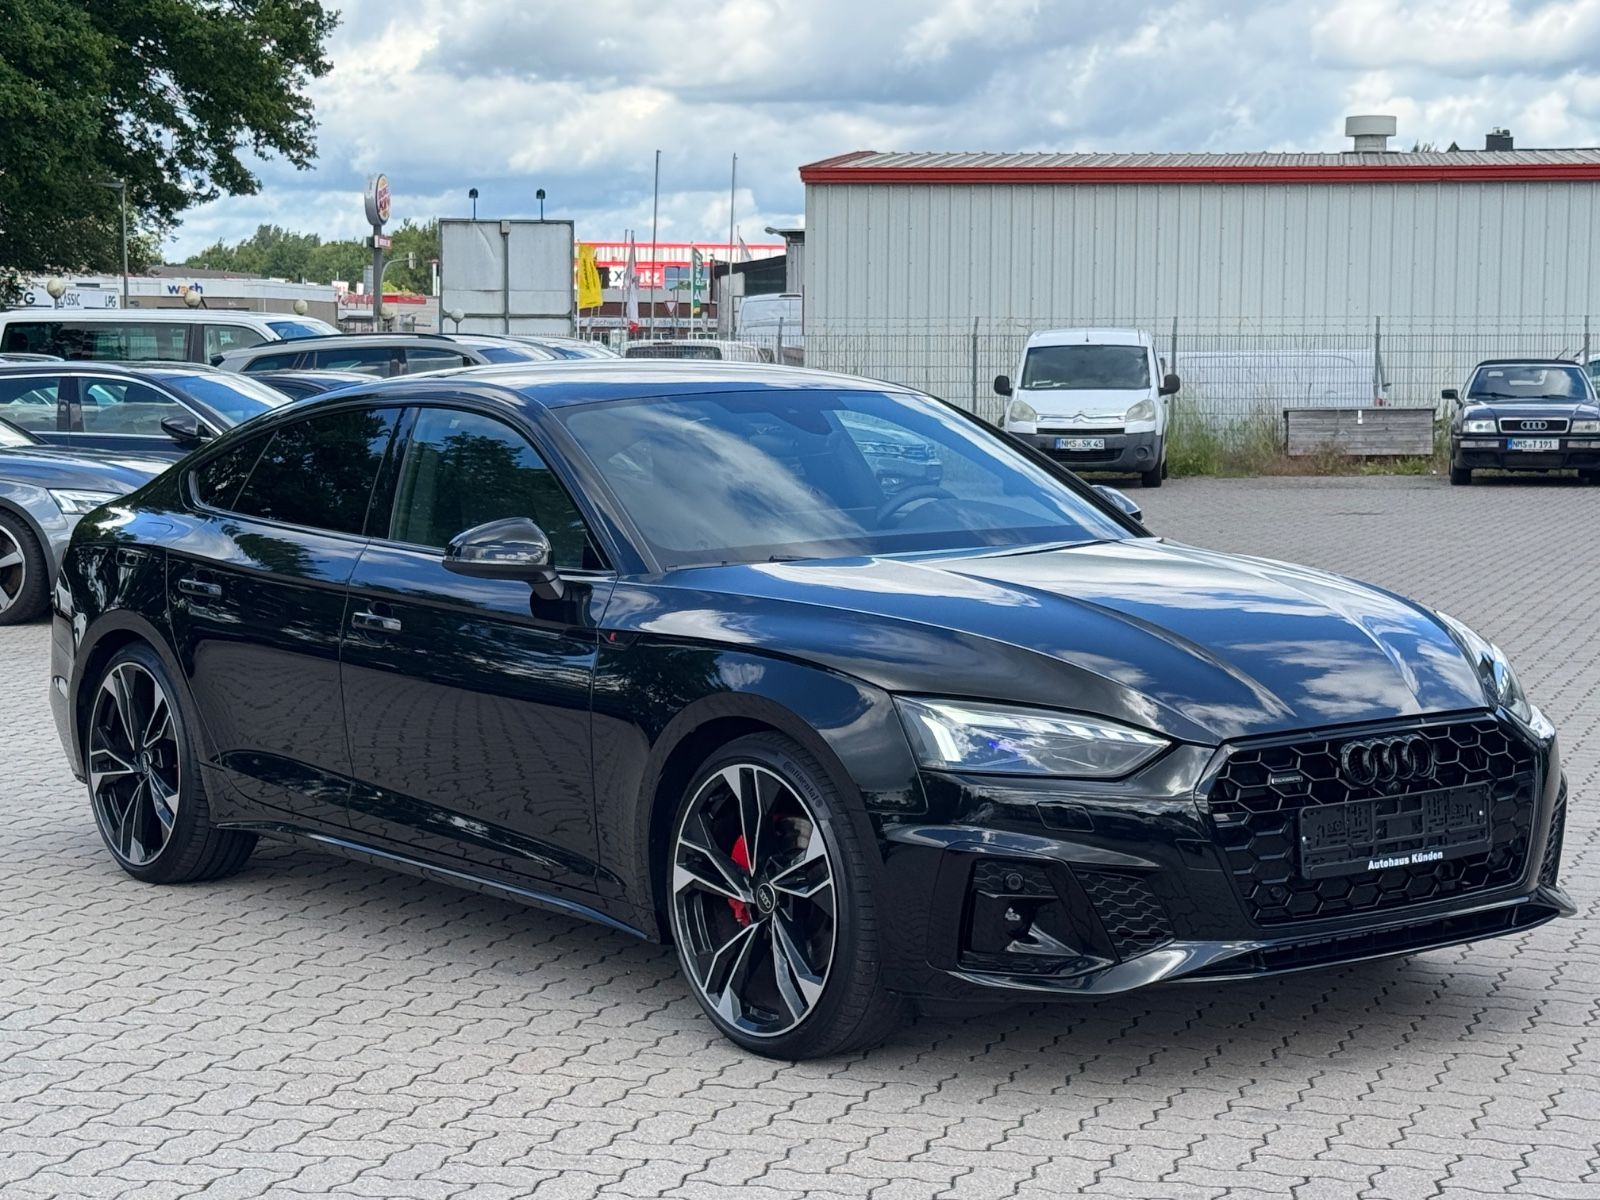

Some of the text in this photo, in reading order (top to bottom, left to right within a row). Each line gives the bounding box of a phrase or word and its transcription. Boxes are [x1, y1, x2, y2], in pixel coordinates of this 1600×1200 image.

[104, 295, 117, 307] LPG
[1061, 439, 1077, 448] NMS
[1082, 439, 1092, 448] SK
[1513, 440, 1527, 448] NMS
[1539, 440, 1553, 448] 191
[1367, 851, 1443, 871] Autohaus Künden
